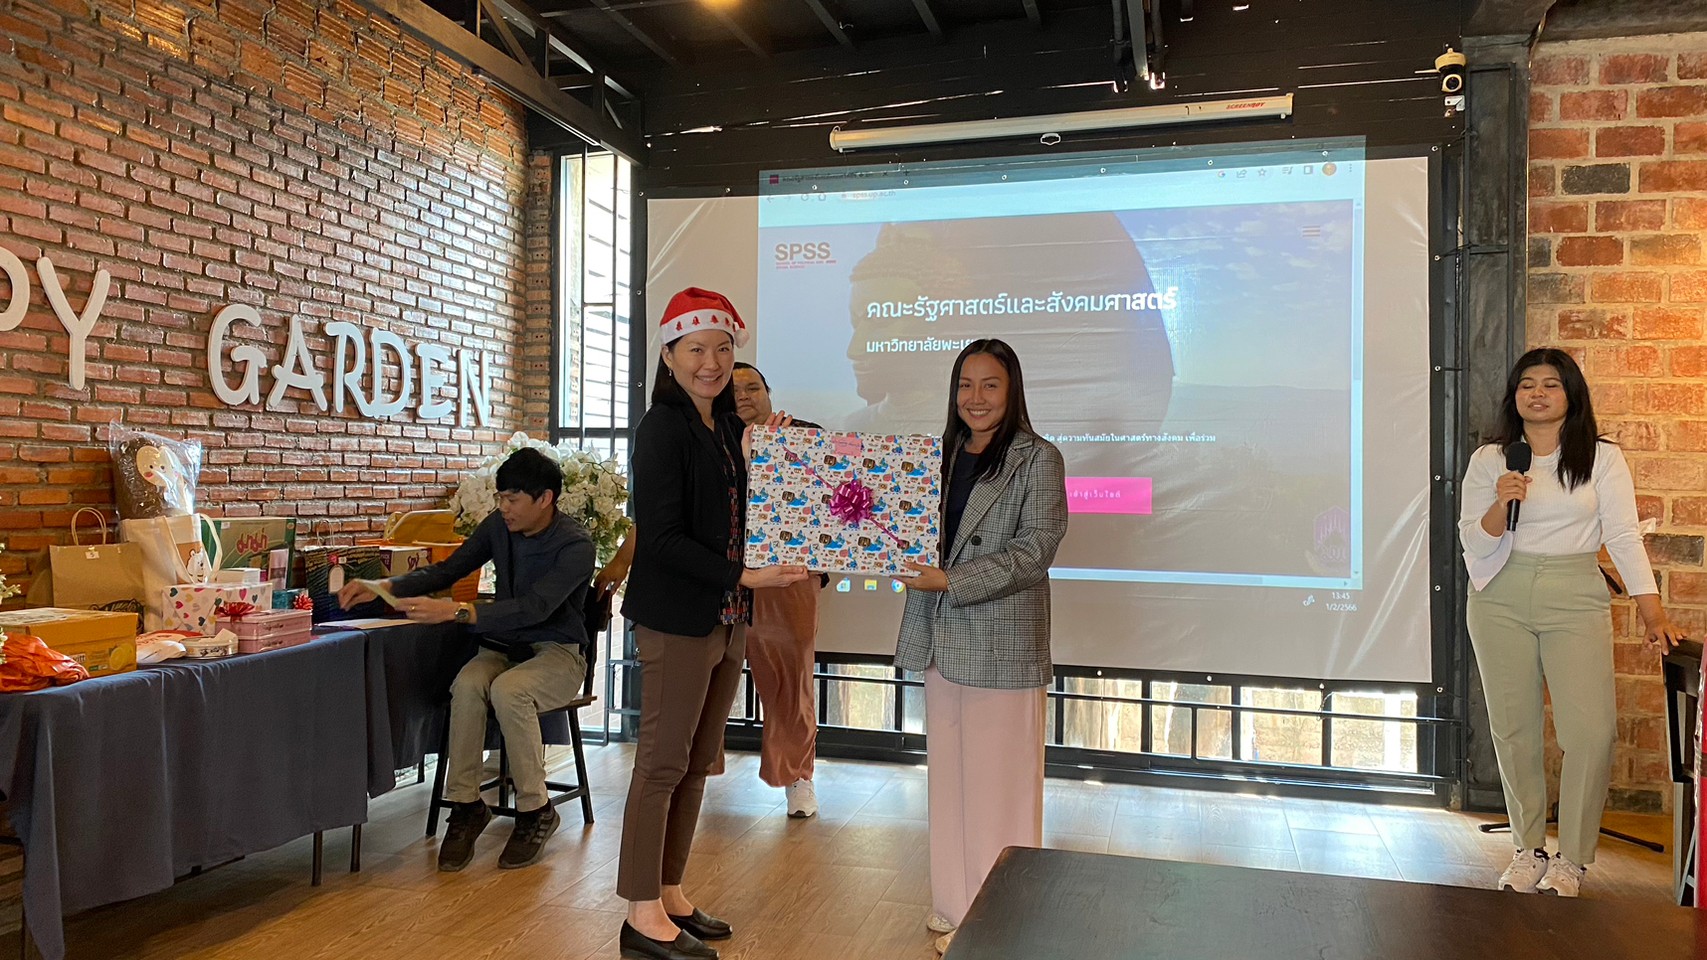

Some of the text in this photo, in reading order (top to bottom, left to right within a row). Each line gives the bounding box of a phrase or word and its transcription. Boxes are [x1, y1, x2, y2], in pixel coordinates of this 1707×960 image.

[774, 241, 832, 262] SPSS
[866, 285, 1179, 322] คณะรัฐศาสตร์และสังคมศาสตร์
[207, 304, 491, 428] GARDEN
[1331, 591, 1351, 600] 13:45
[1326, 602, 1358, 612] 1/2/2566
